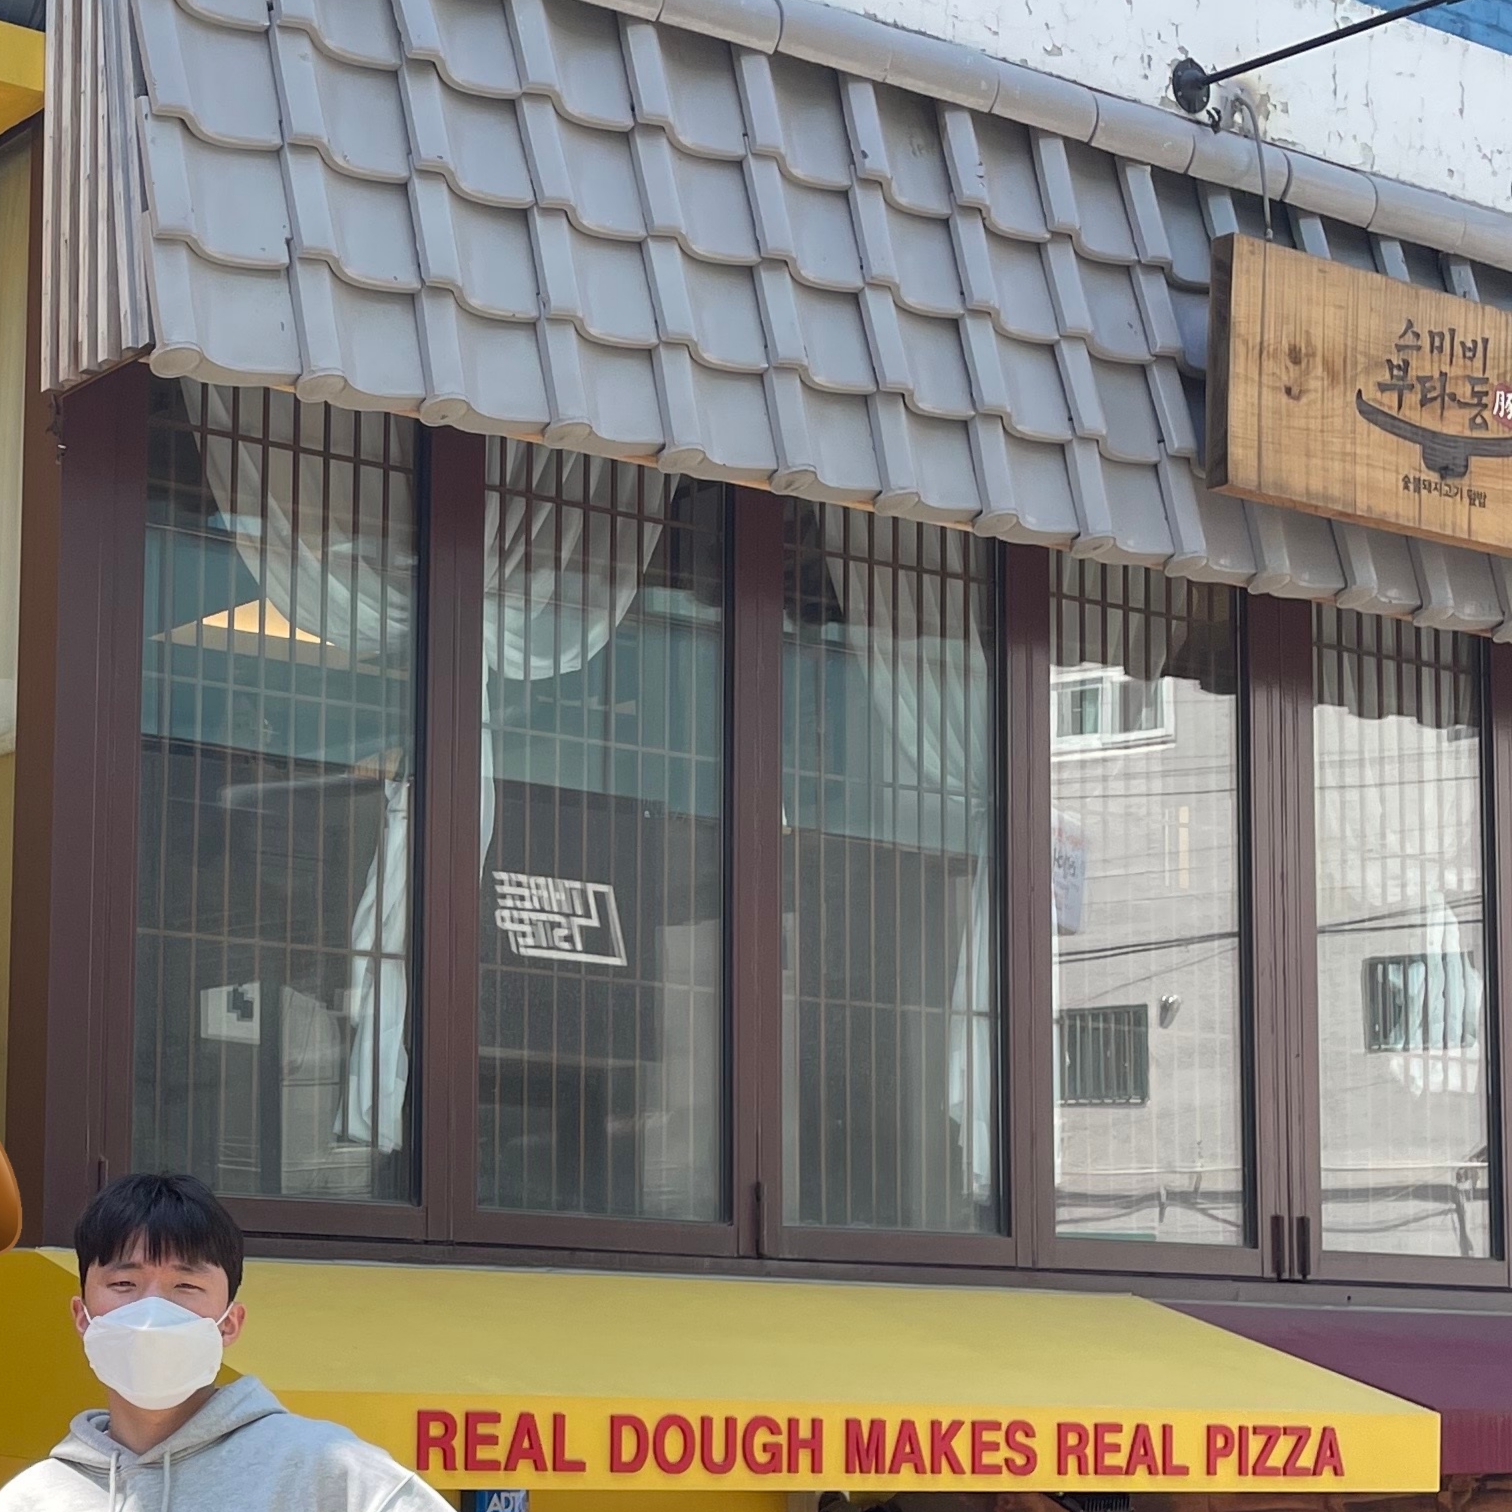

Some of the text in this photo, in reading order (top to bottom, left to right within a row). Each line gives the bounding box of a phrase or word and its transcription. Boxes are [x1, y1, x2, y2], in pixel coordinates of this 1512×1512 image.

[1394, 319, 1490, 375] 스미비
[1377, 358, 1490, 431] 부타동
[417, 1411, 1345, 1478] REAL DOUGH MAKES REAL PIZZA
